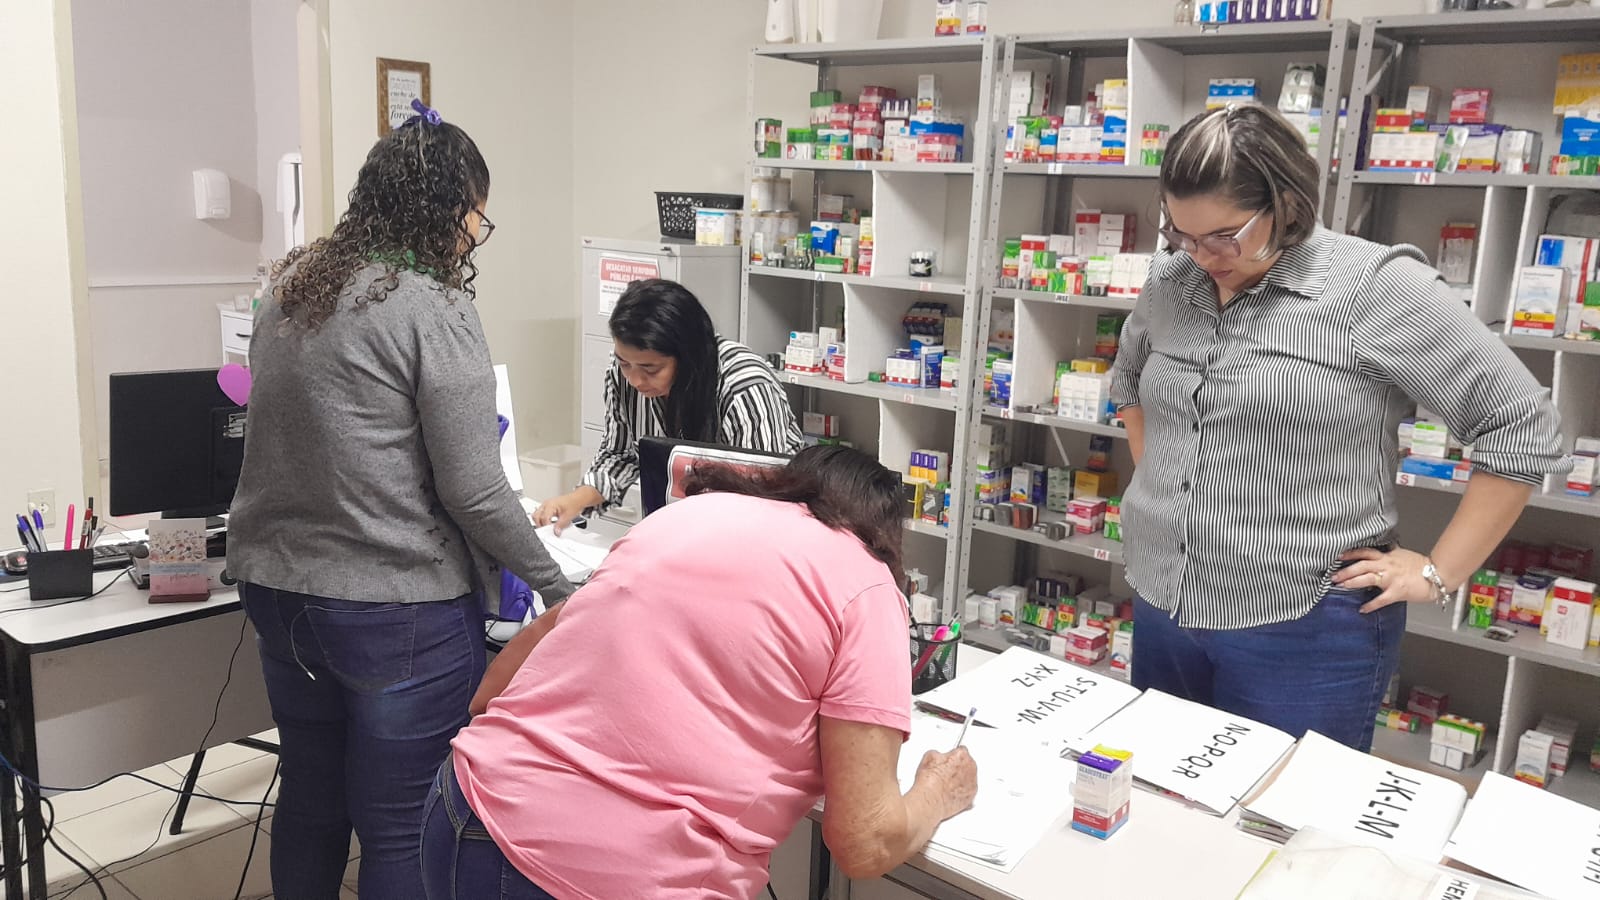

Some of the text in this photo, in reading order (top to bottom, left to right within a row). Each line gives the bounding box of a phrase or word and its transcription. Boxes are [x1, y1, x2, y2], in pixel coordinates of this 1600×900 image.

[1420, 172, 1431, 183] N
[1400, 474, 1409, 485] S
[1096, 550, 1106, 560] M
[1010, 663, 1059, 687] X-Y-Z
[1171, 722, 1251, 779] N-O-P-Q-R
